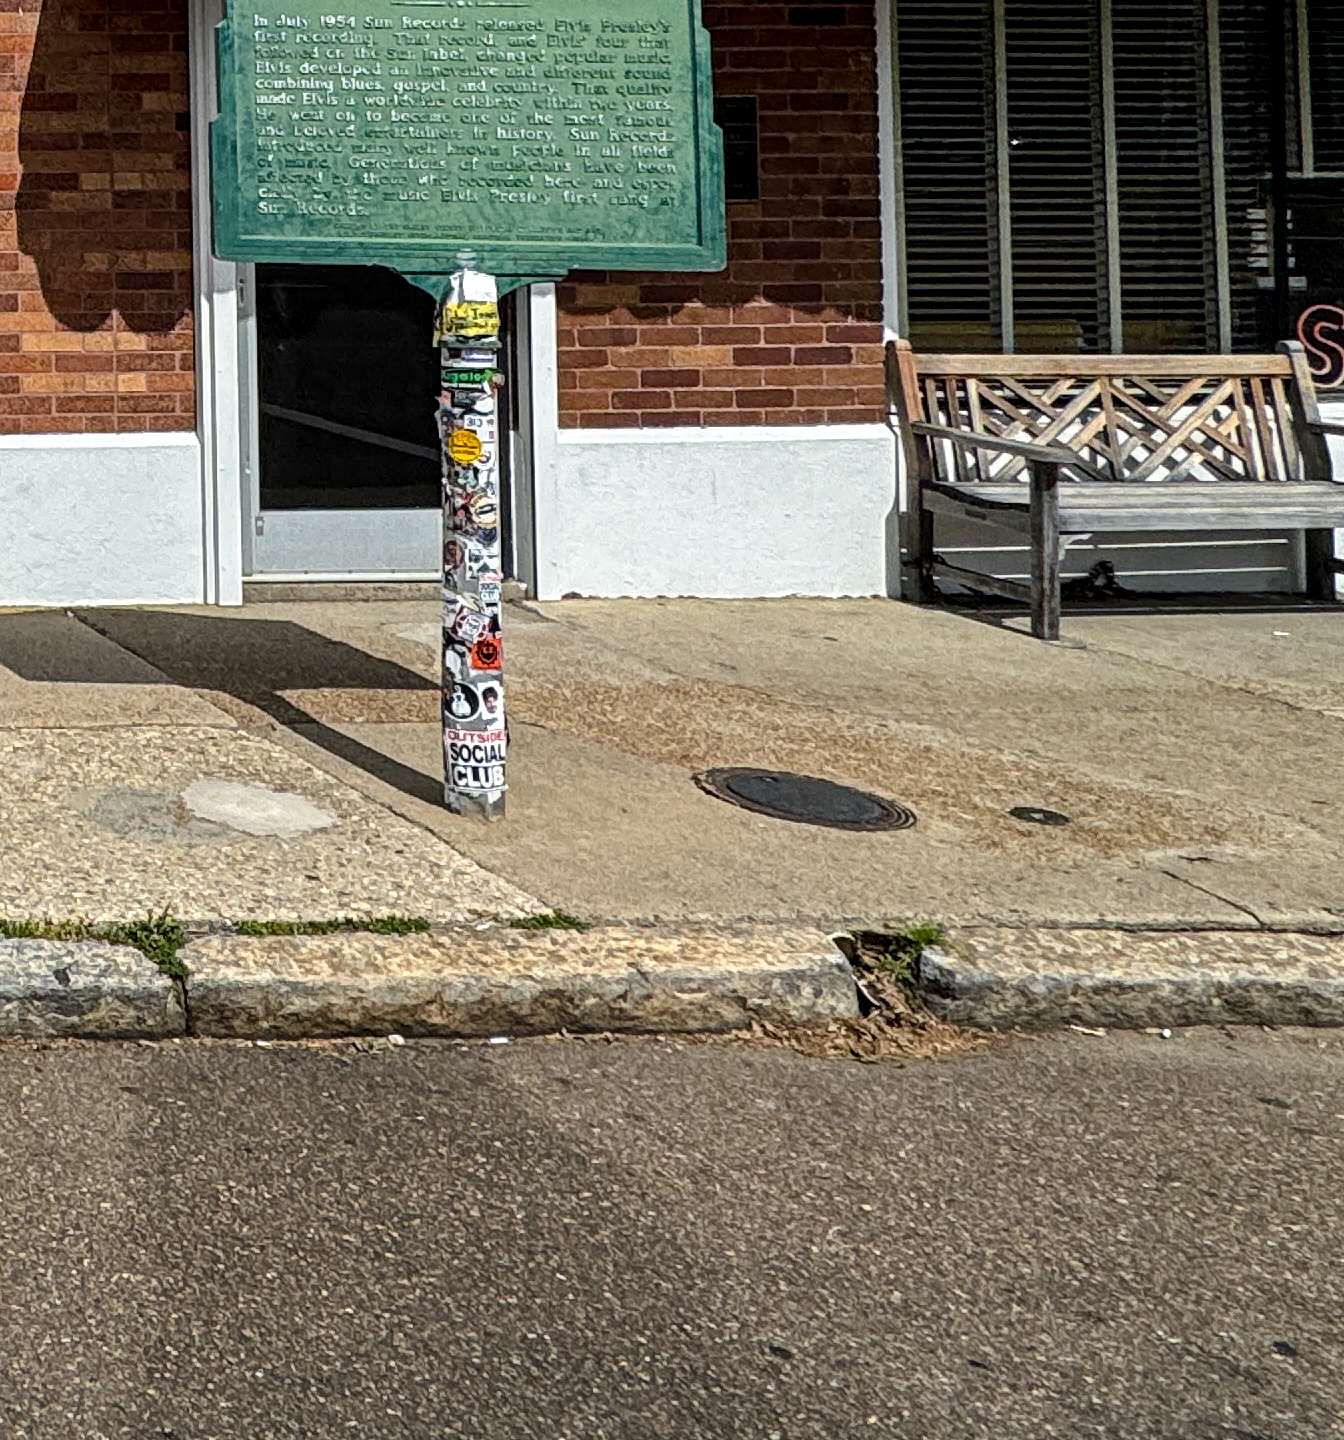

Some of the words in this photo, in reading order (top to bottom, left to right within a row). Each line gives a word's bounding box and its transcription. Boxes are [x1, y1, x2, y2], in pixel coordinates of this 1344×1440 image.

[254, 13, 269, 28] In
[363, 16, 393, 29] Sun
[508, 35, 537, 48] and
[255, 61, 292, 75] Elvis
[299, 62, 382, 77] developed
[505, 64, 535, 78] and
[255, 77, 334, 93] combining
[457, 80, 488, 93] and
[302, 92, 338, 106] Elvis
[365, 110, 382, 123] to
[569, 128, 600, 142] Sun
[448, 730, 505, 742] OUTSIDE
[450, 742, 505, 763] SOCIAL
[454, 765, 505, 787] CLUB
